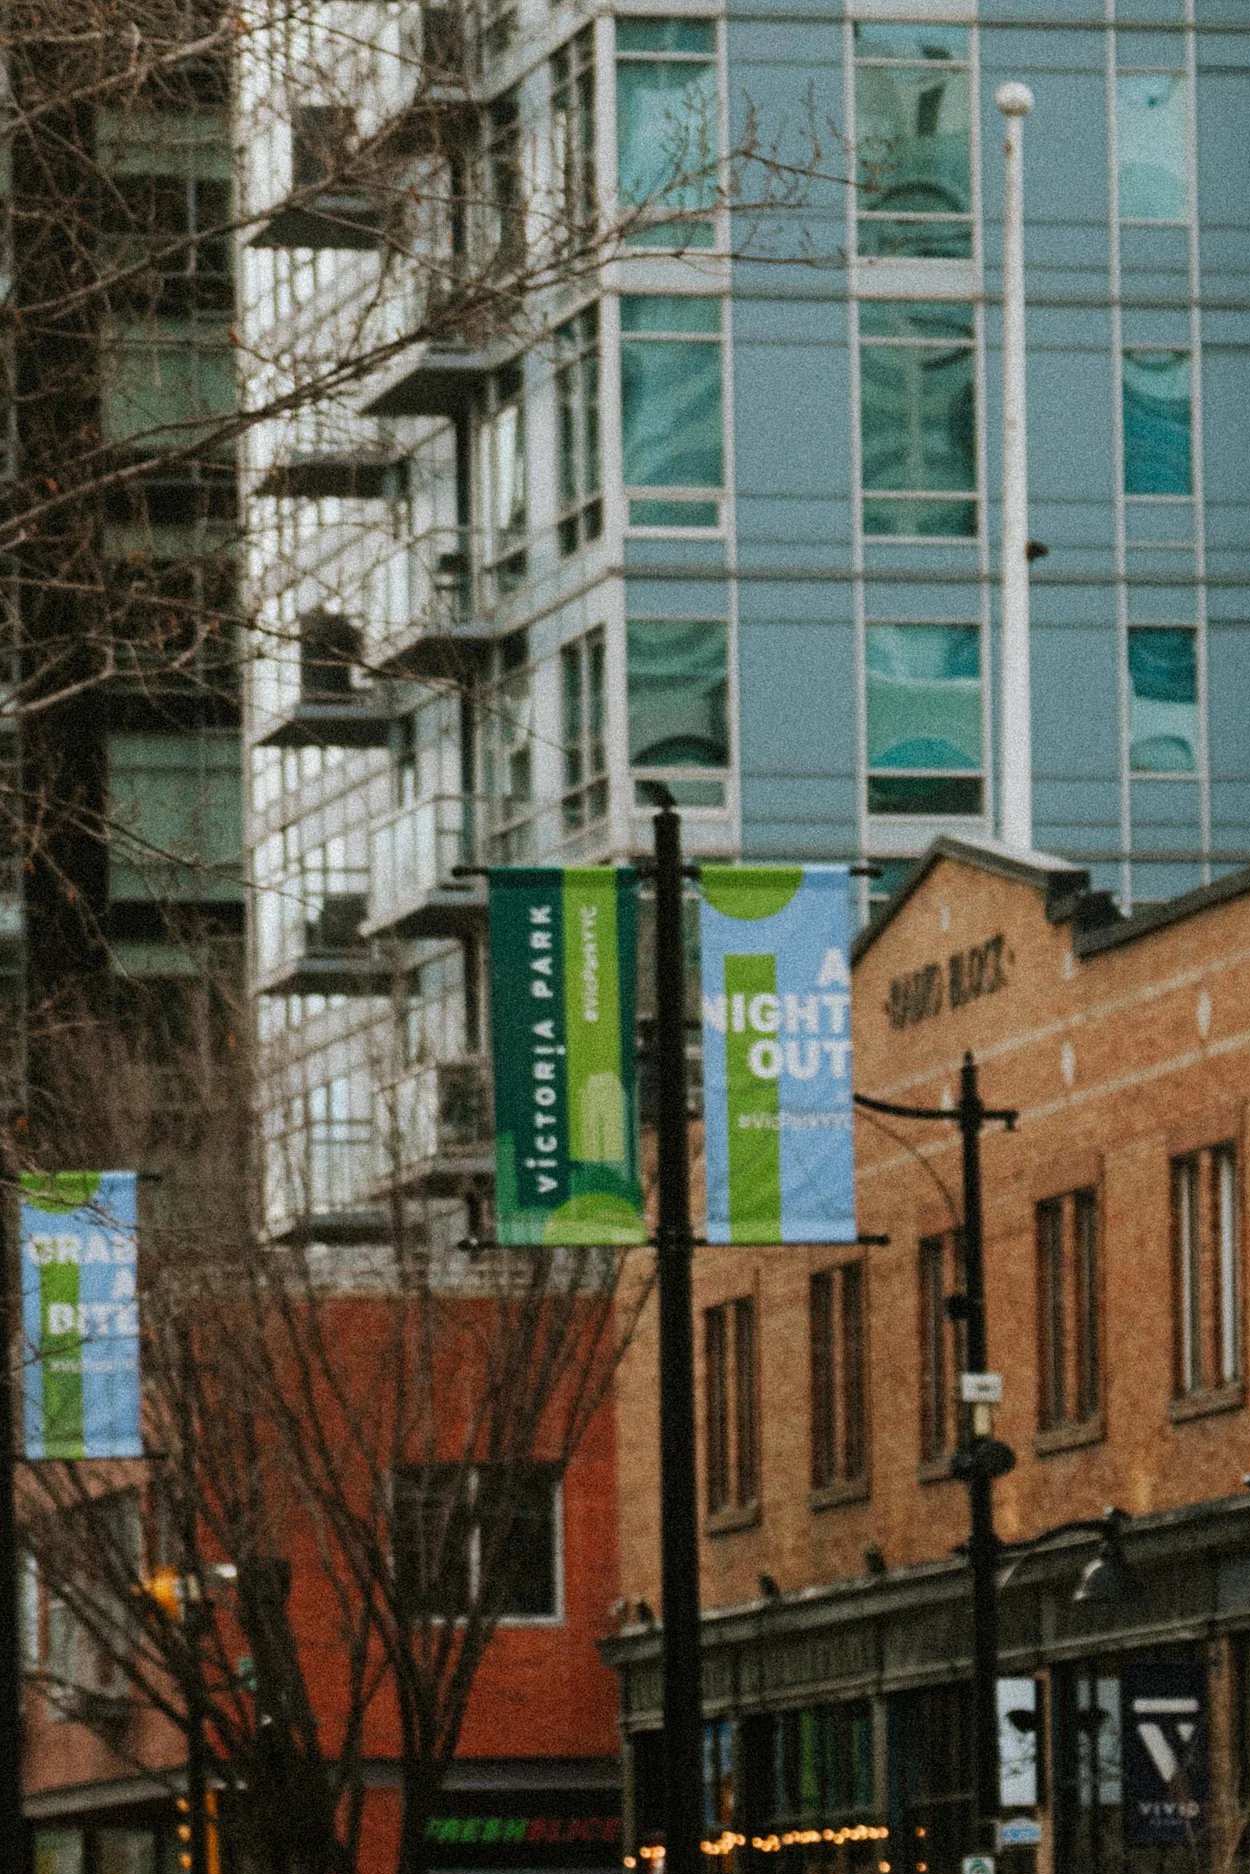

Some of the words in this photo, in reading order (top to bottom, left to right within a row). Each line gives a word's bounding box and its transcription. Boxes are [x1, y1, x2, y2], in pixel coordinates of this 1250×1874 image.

[529, 905, 553, 999] PARK
[818, 947, 850, 988] A
[702, 992, 853, 1034] NIGHT
[747, 1039, 853, 1080] OUT
[112, 1267, 136, 1299] A
